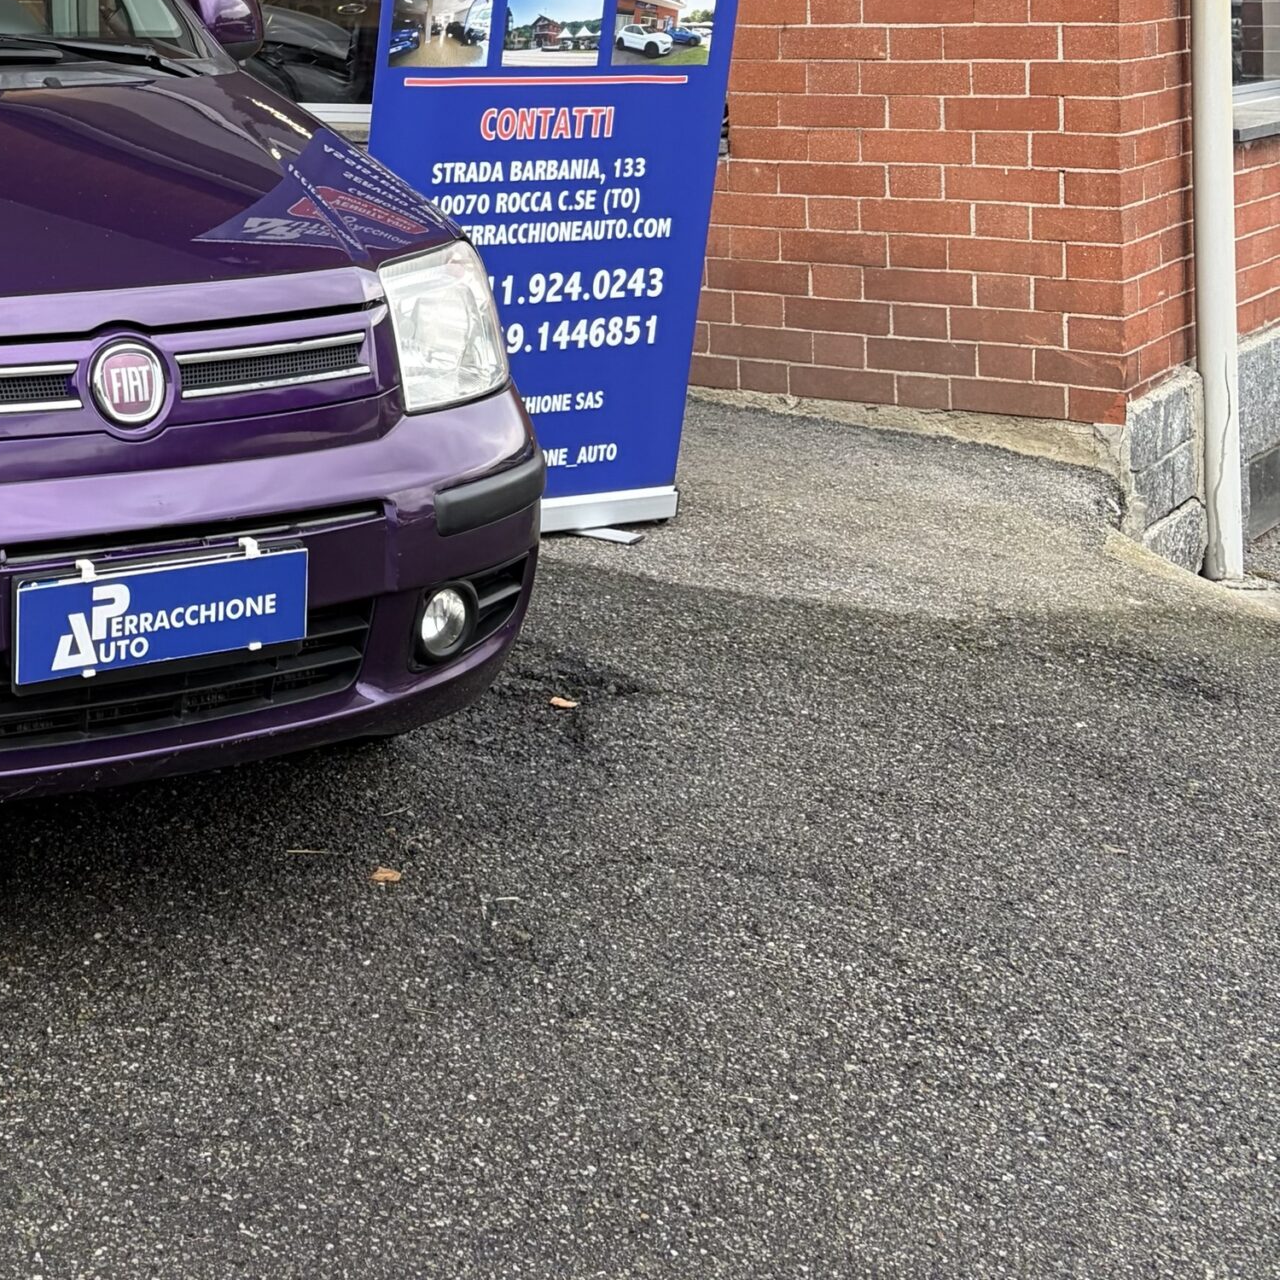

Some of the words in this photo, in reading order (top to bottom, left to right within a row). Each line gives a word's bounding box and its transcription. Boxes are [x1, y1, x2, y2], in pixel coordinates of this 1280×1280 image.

[480, 106, 615, 141] CONTATTI
[431, 162, 504, 184] STRADA
[509, 158, 606, 184] BARBANIA,
[614, 157, 646, 178] 133
[495, 191, 552, 214] ROCCA
[558, 189, 597, 211] C.SE
[604, 188, 641, 215] (TO)
[500, 315, 658, 354] 9.1446851
[109, 364, 151, 405] FIAT
[521, 393, 572, 414] HIONE
[575, 390, 604, 410] SAS
[92, 583, 276, 640] PERRACCHIONE
[51, 612, 149, 671] AUTO
